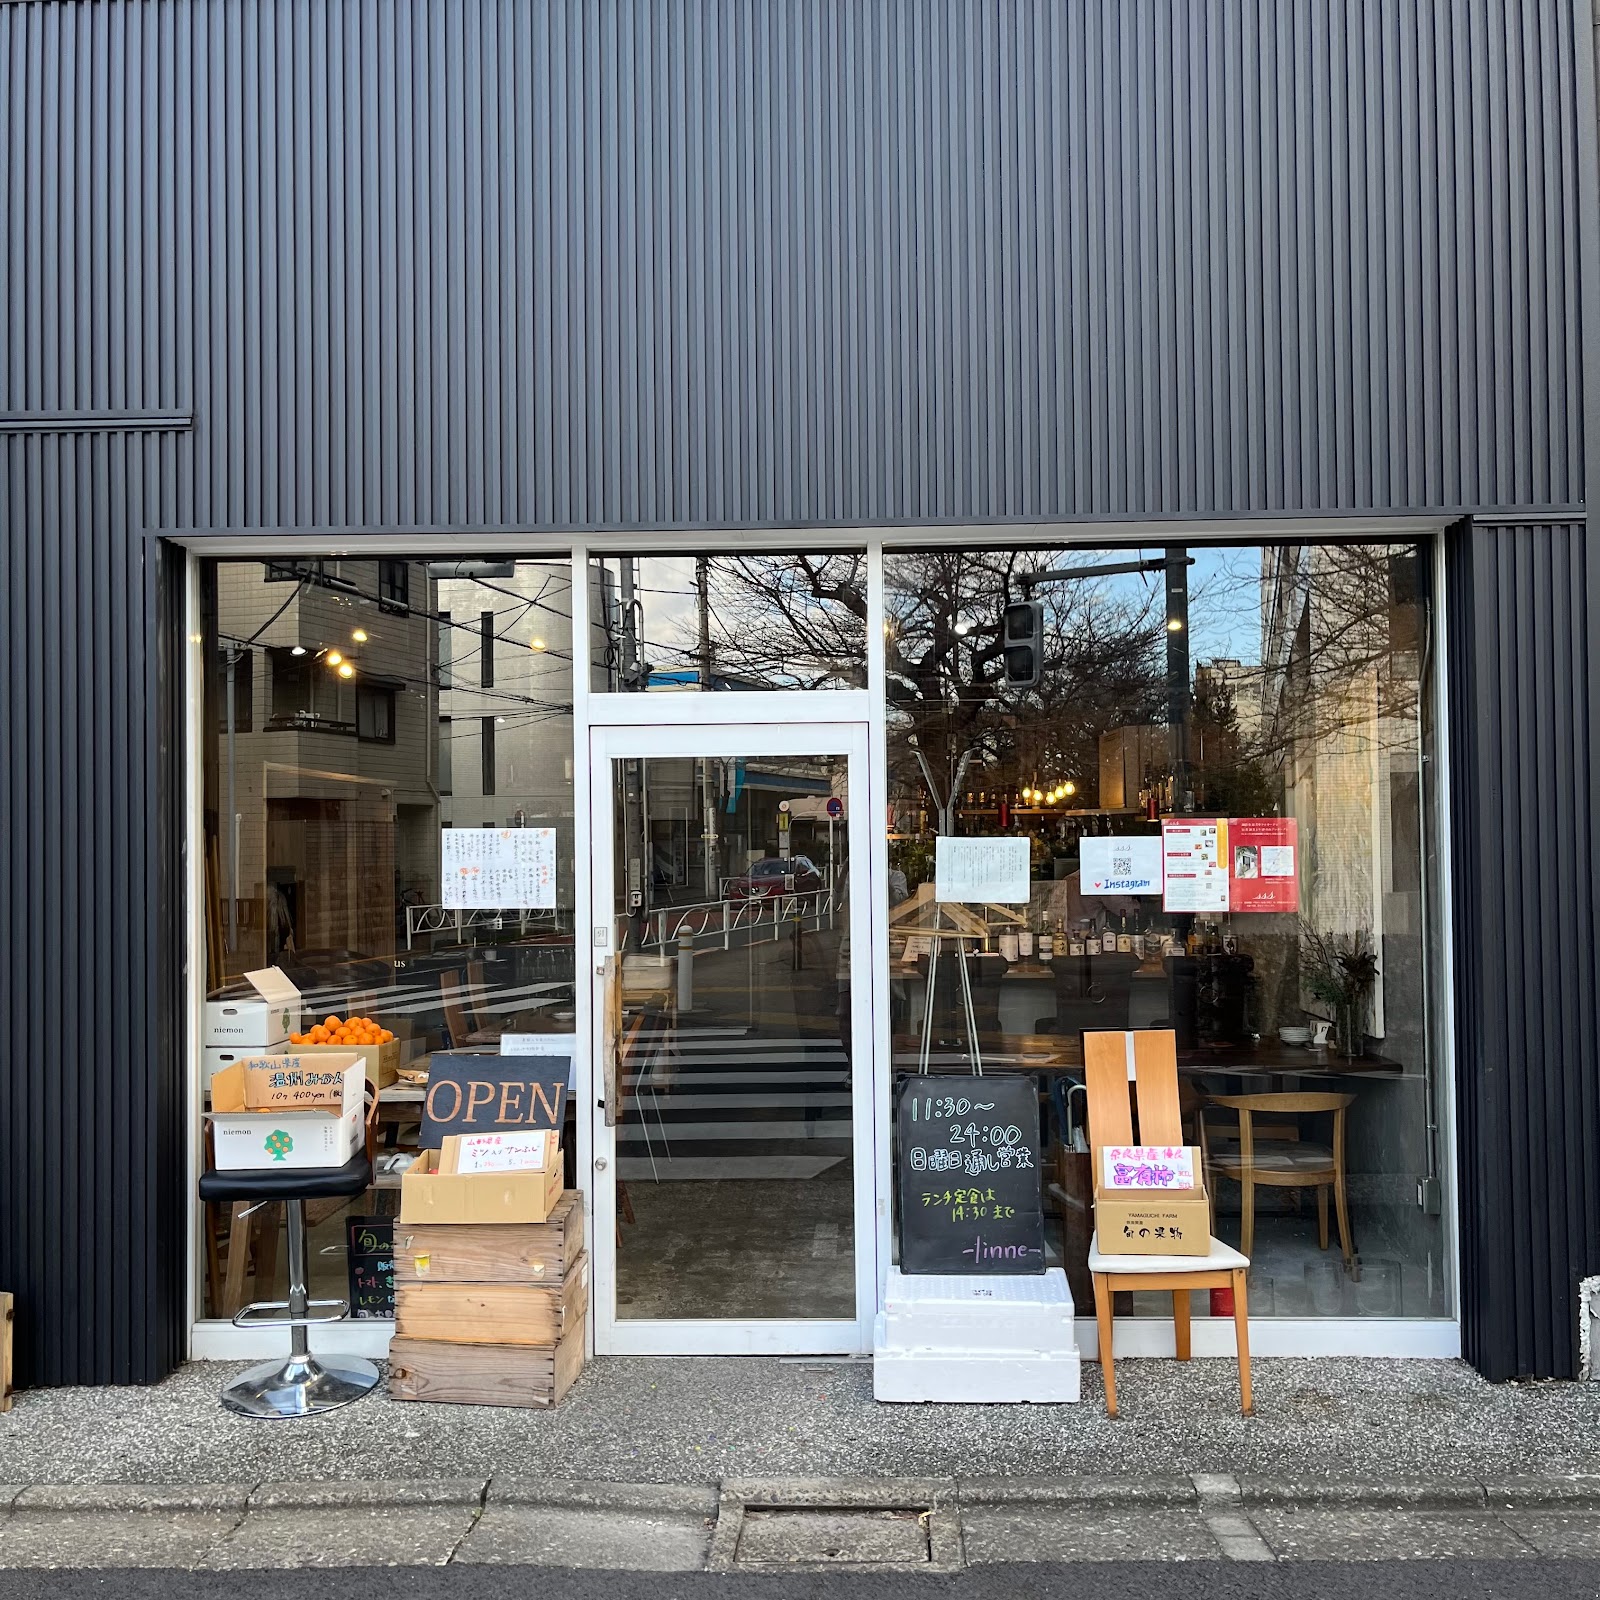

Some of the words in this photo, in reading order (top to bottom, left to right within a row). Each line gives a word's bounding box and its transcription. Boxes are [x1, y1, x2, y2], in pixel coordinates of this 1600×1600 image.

[1104, 879, 1151, 891] Instagram
[393, 960, 406, 968] us
[248, 1057, 301, 1071] 和歌山県産
[268, 1071, 343, 1089] 温州みかん
[426, 1079, 565, 1125] OPEN
[949, 1122, 1022, 1148] 24:00
[910, 1146, 1034, 1176] 日曜日通し営業
[1114, 1163, 1175, 1187] 富有柿
[921, 1188, 996, 1207] ランチ定食は
[952, 1206, 987, 1222] 14:30
[993, 1206, 1015, 1219] まで
[358, 1229, 393, 1253] 旬の
